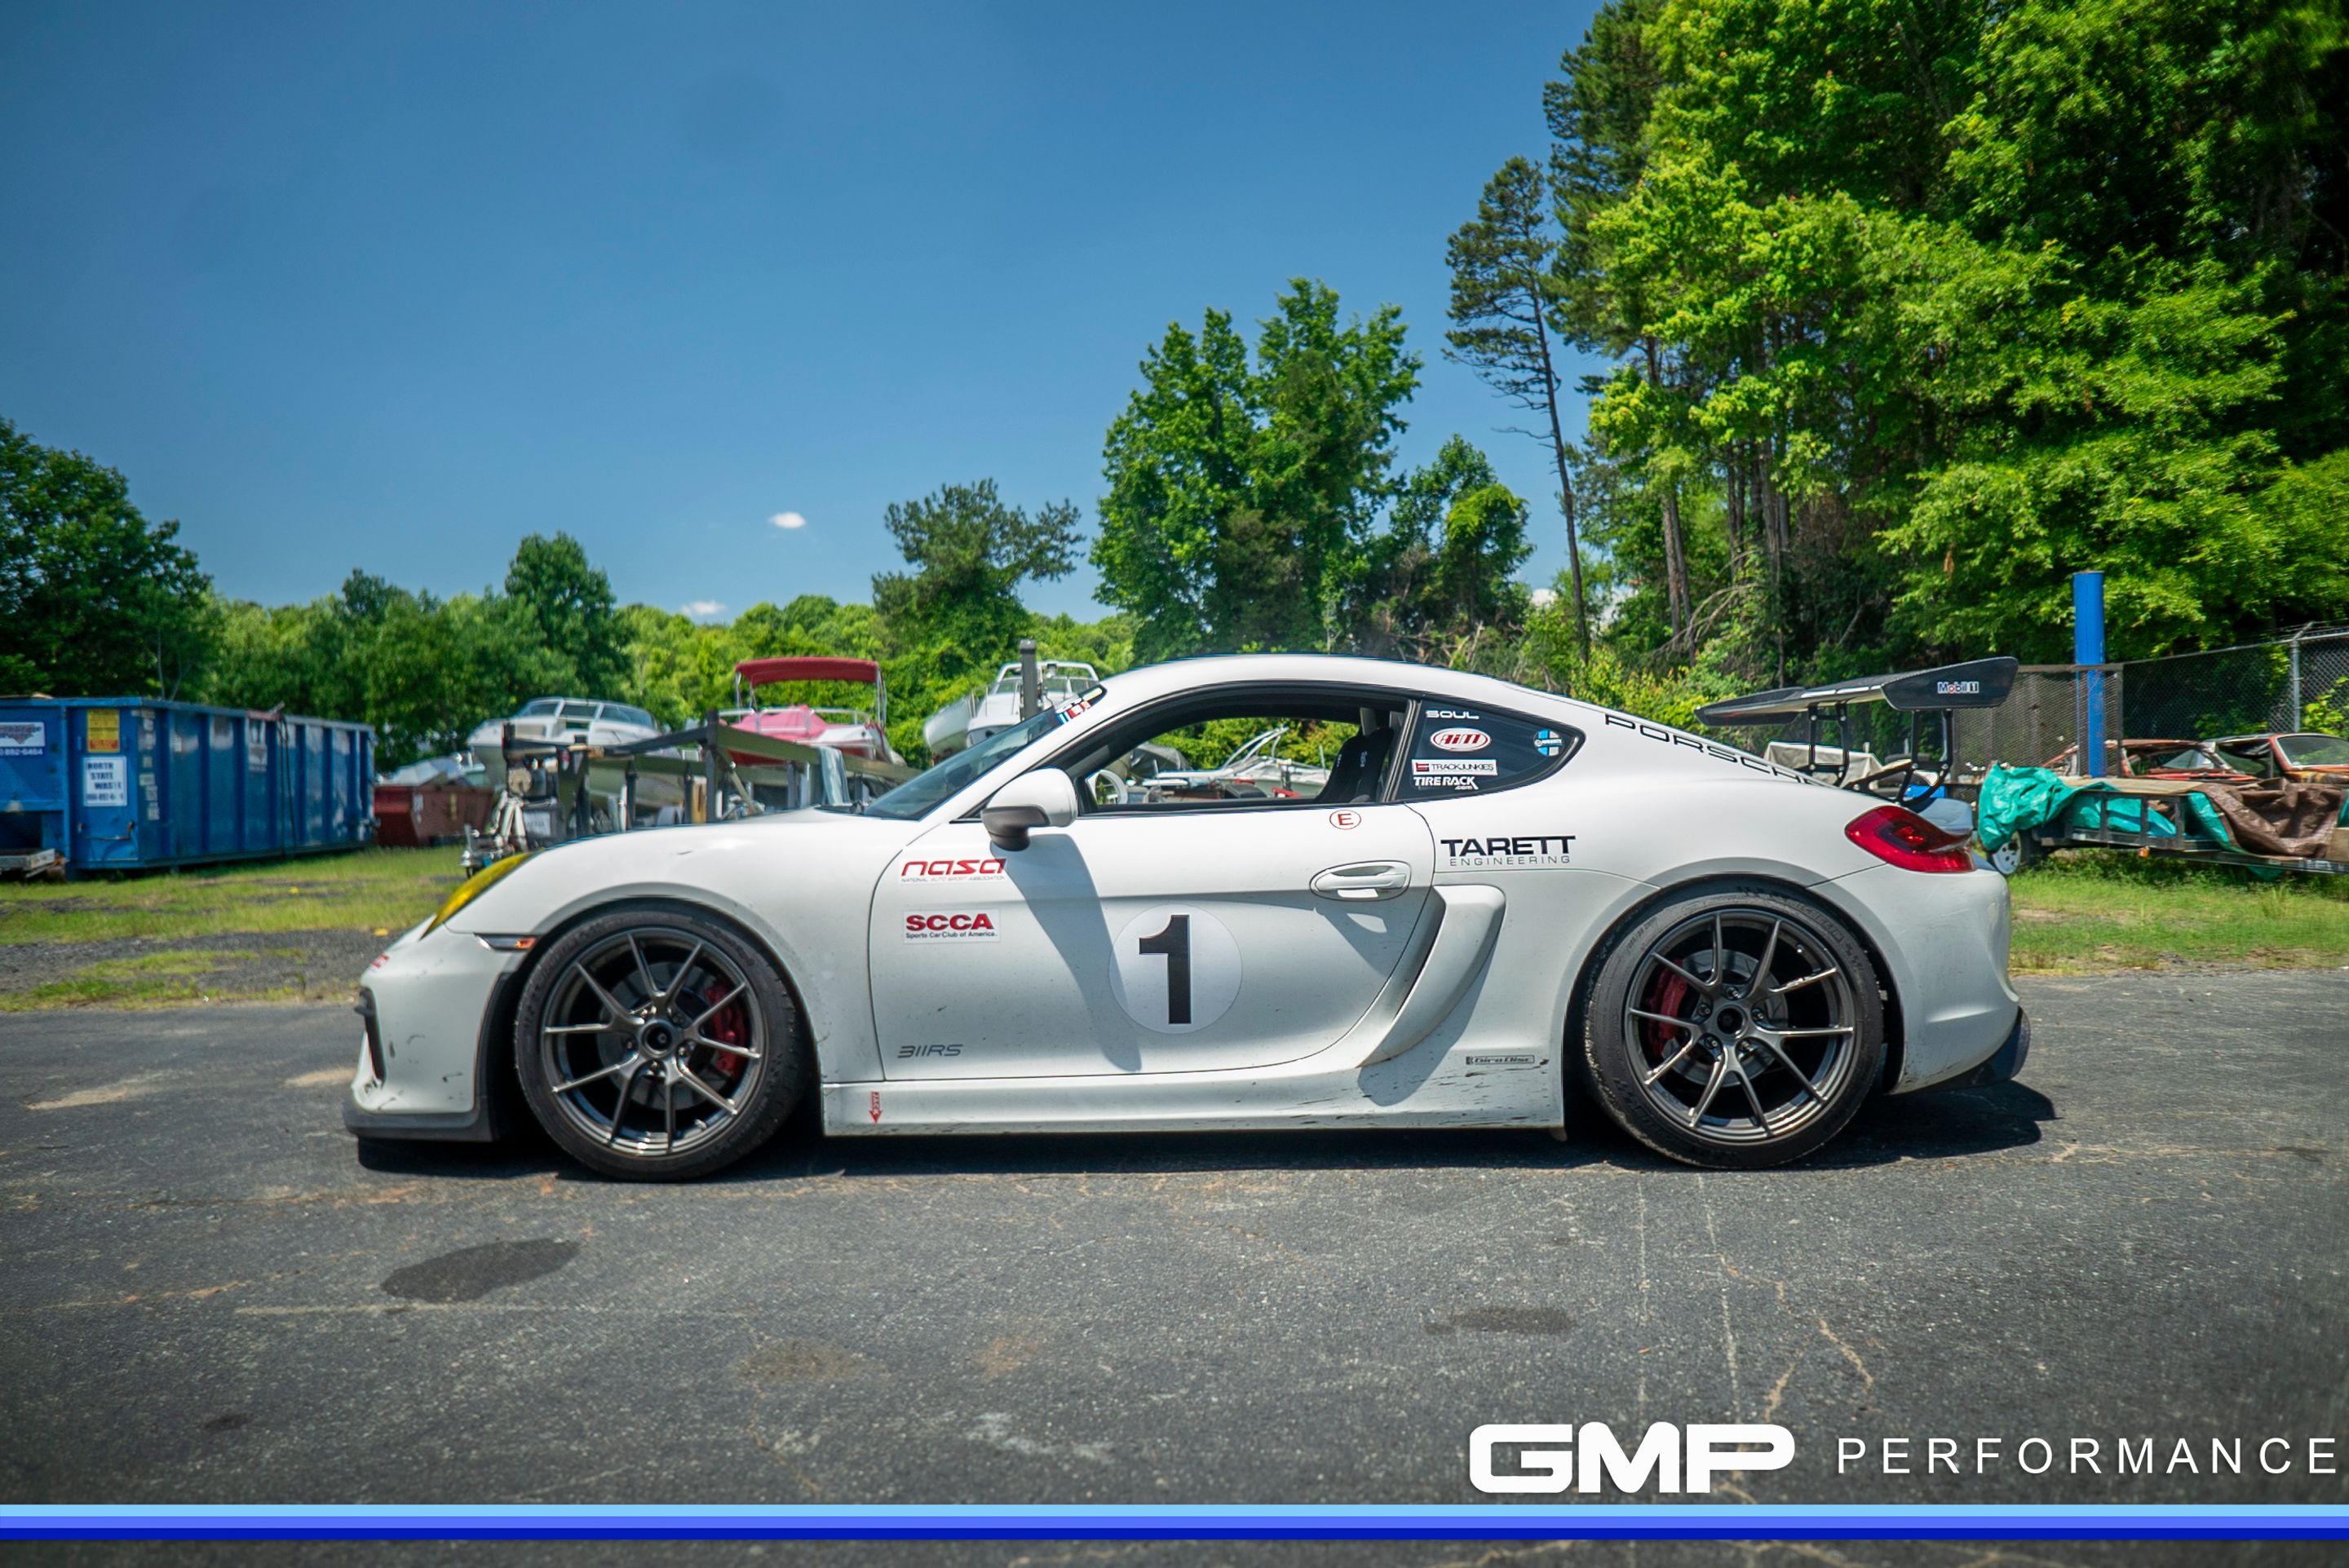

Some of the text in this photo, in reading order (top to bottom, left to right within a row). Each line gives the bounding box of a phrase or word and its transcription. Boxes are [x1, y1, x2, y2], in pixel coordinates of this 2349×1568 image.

[1937, 682, 1967, 694] Mobil
[1426, 710, 1480, 720] SOUL
[1431, 763, 1494, 771] TRACKJUNKIES
[1413, 775, 1480, 790] TIRE RACK
[1338, 813, 1354, 826] E
[1440, 835, 1577, 858] TARETT
[900, 858, 1007, 877] nasa
[1449, 855, 1571, 867] ENGINEERING
[905, 913, 995, 931] SCCA
[906, 932, 928, 940] Sports
[942, 930, 958, 939] Club
[1139, 914, 1192, 1025] 1
